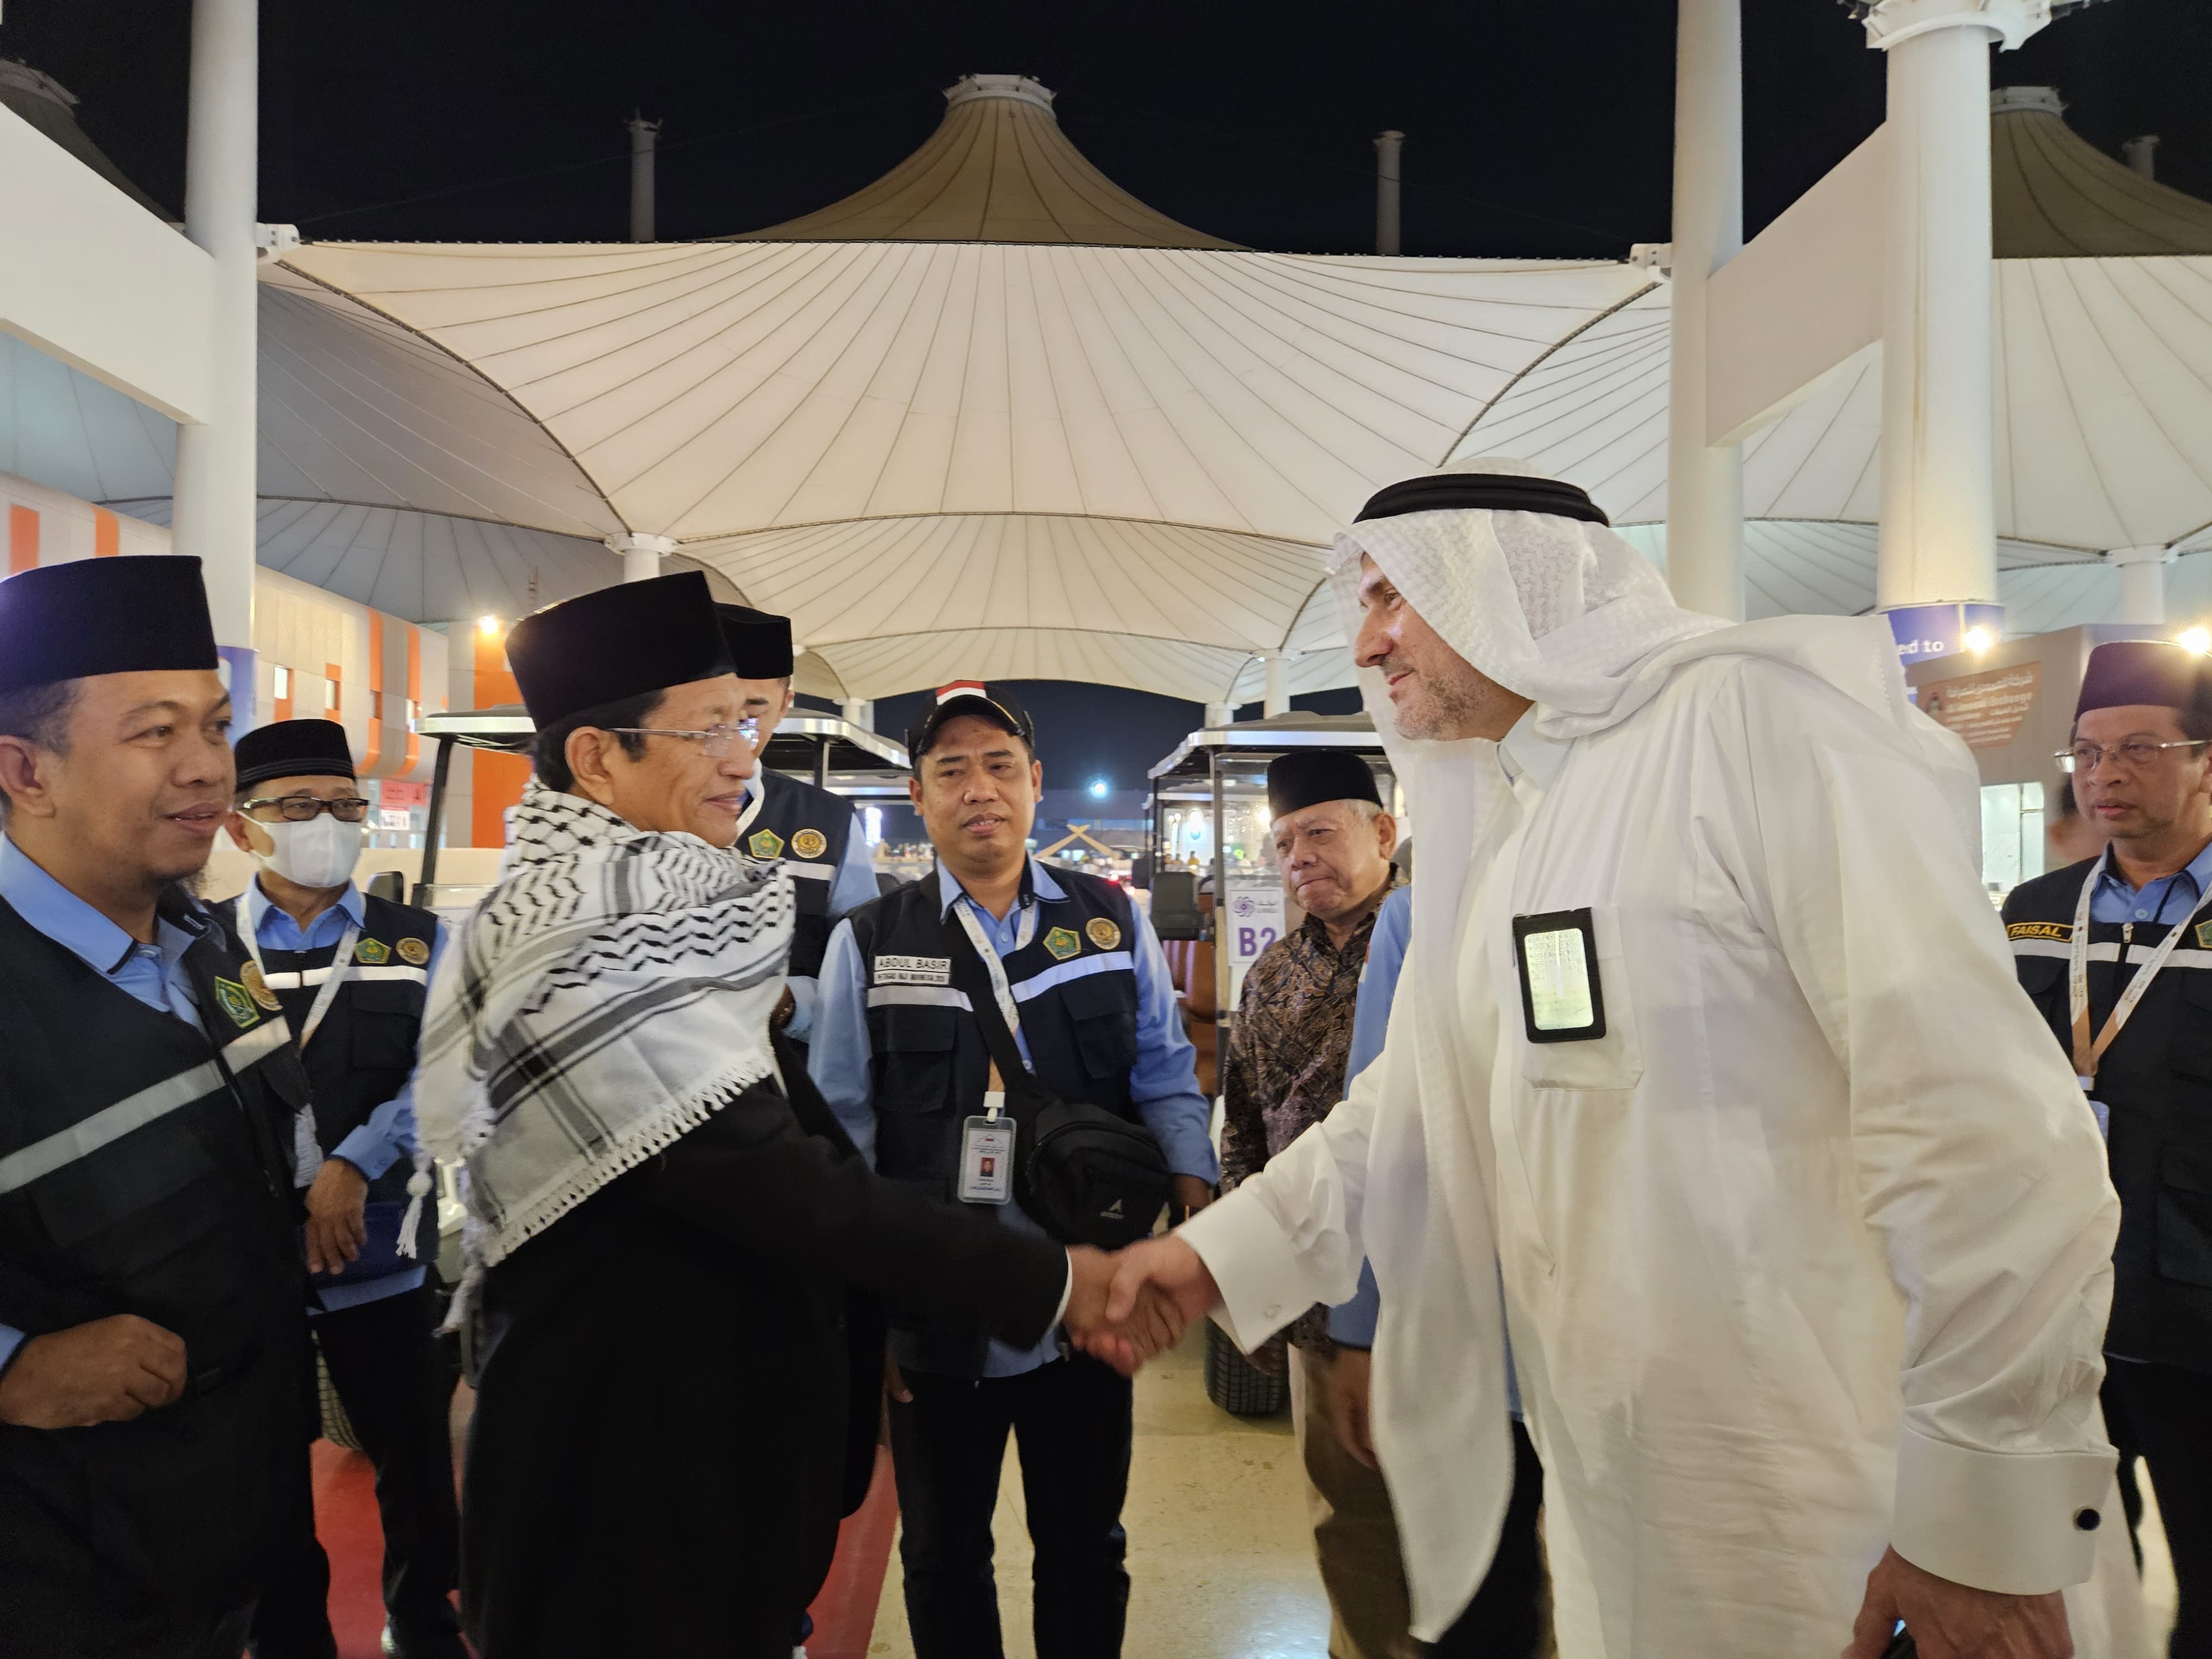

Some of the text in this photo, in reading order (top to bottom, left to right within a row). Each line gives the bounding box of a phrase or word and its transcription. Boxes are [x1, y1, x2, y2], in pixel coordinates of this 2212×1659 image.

[1923, 640, 1944, 653] to
[2010, 925, 2062, 937] FAISAL
[1239, 927, 1276, 957] B2
[877, 957, 947, 970] ABDUL BASIR
